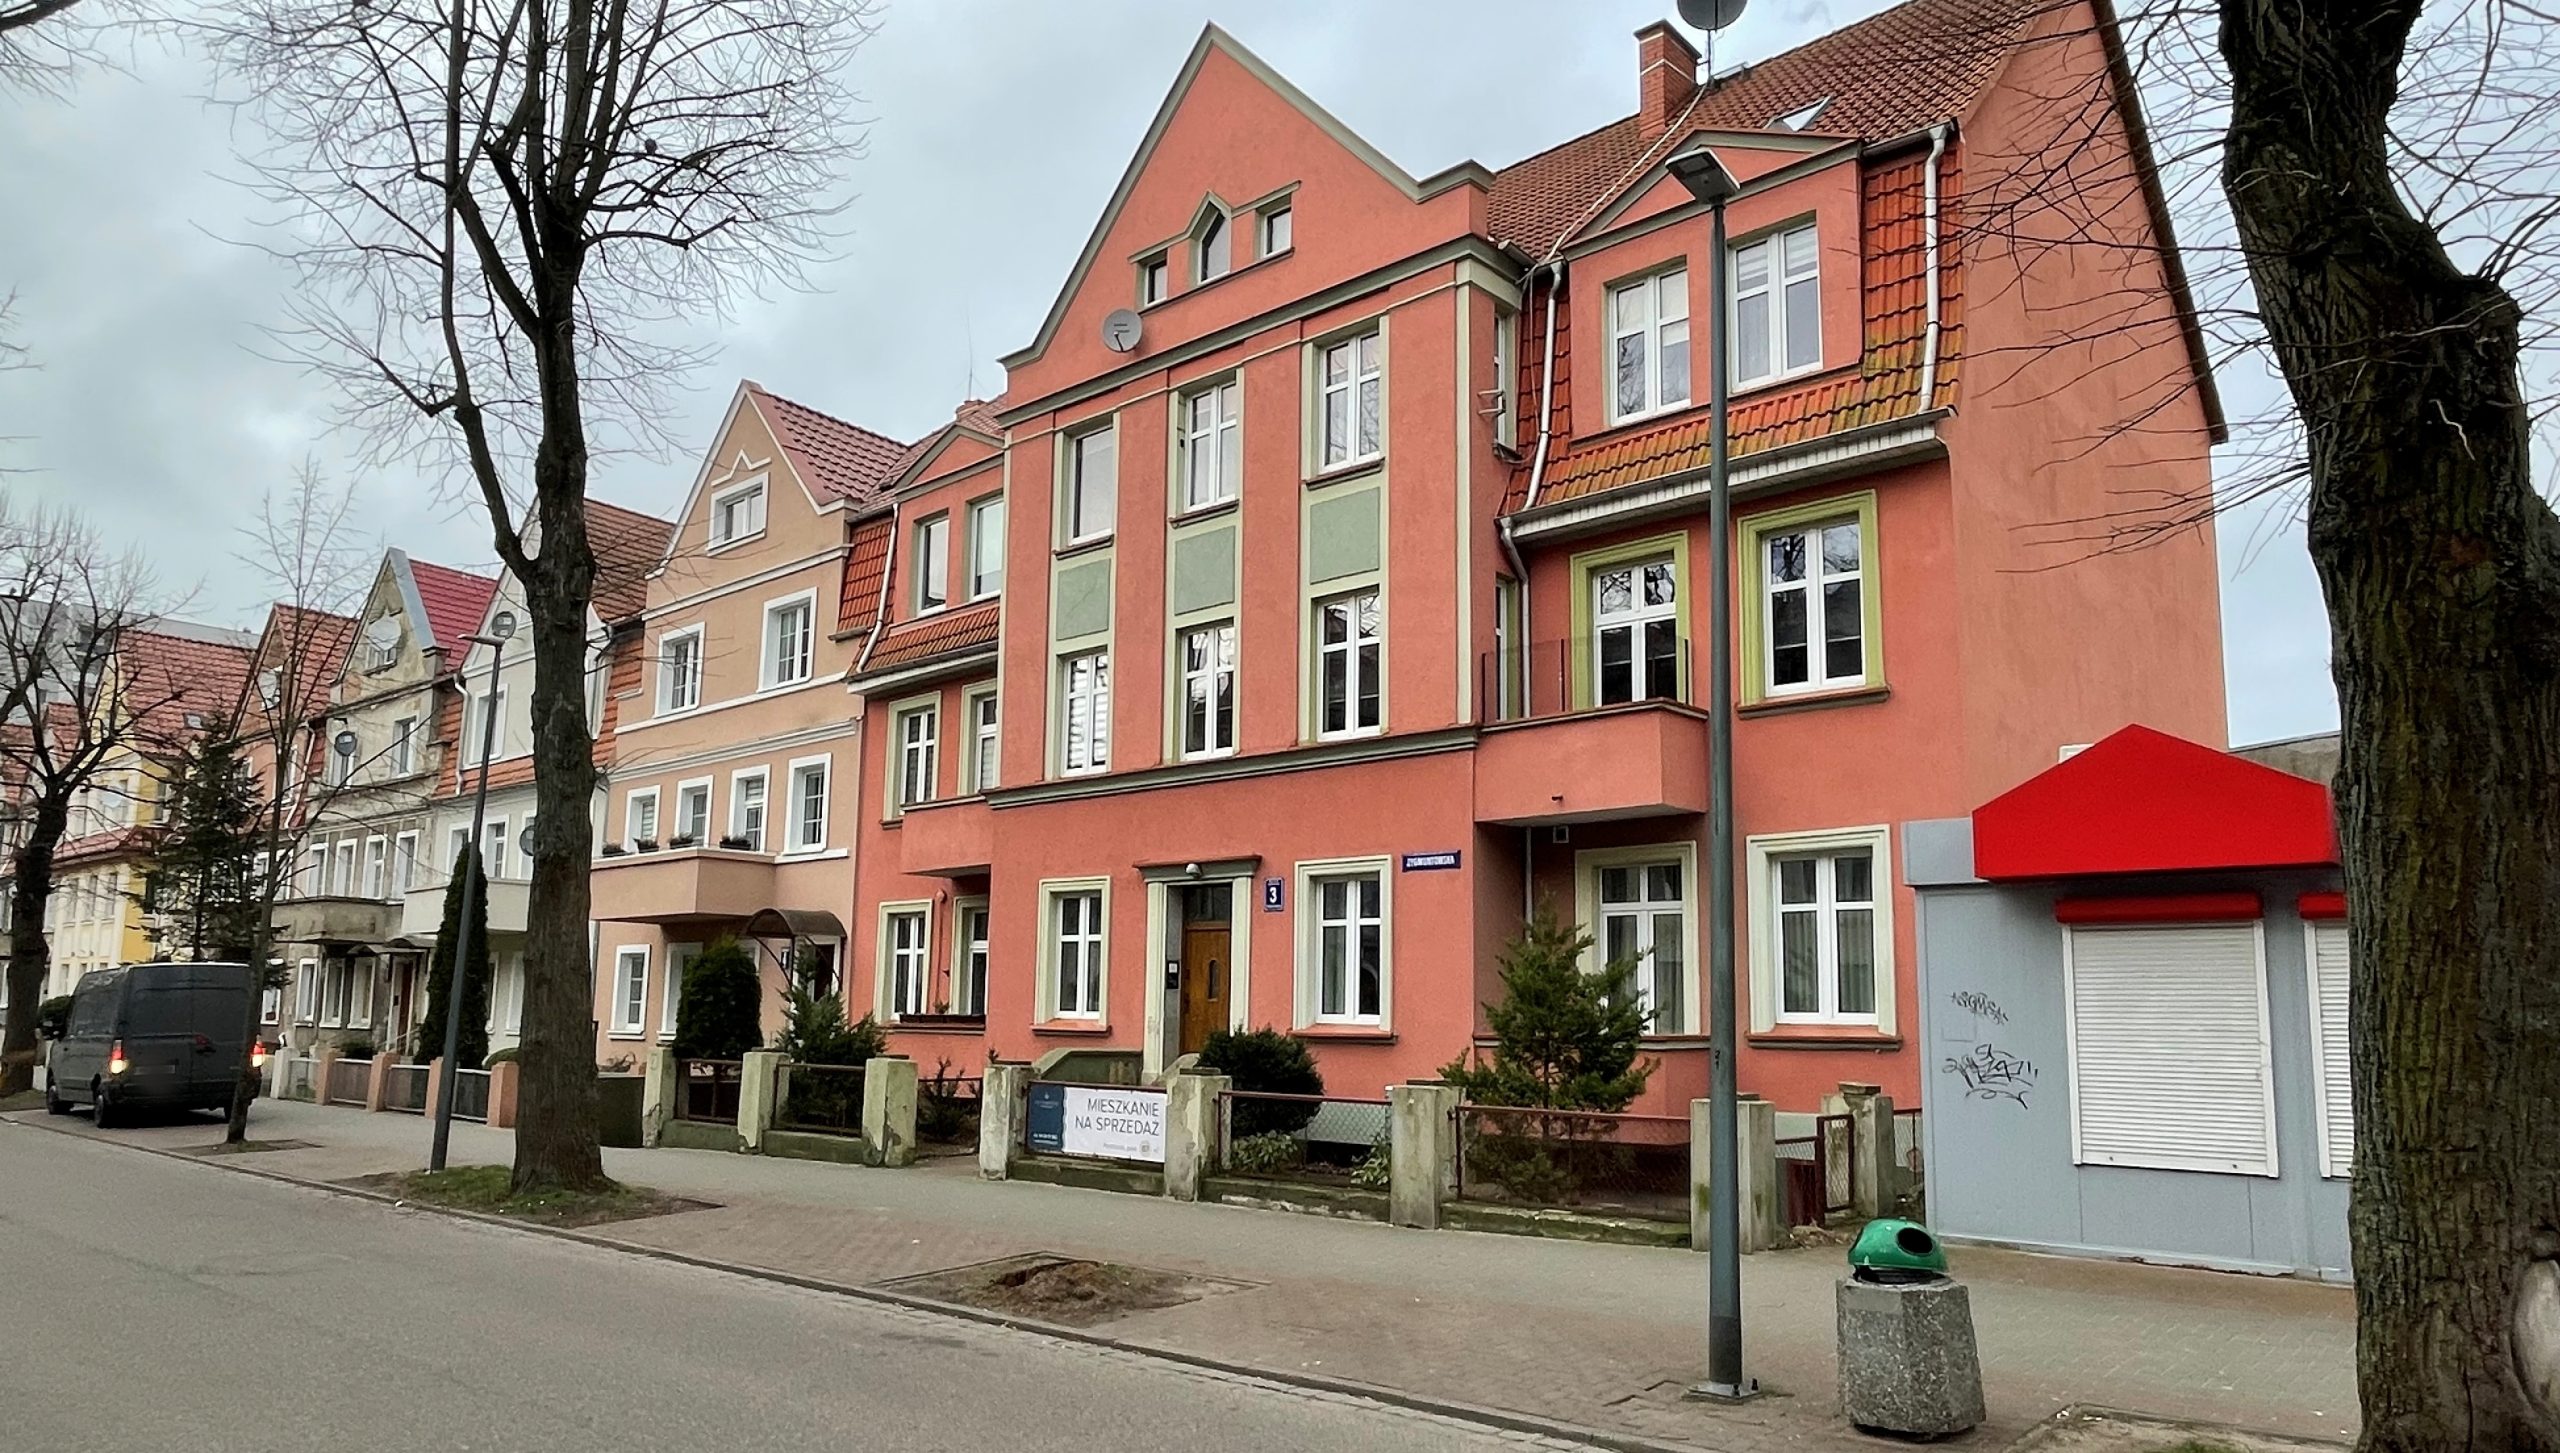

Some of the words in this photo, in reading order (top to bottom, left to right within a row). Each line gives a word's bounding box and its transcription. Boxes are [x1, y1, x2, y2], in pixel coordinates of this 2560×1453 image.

[1269, 886, 1278, 904] 3
[1087, 1098, 1159, 1117] MIESZKANIE
[1075, 1115, 1092, 1129] NA
[1096, 1117, 1160, 1136] SPRZEDAŻ
